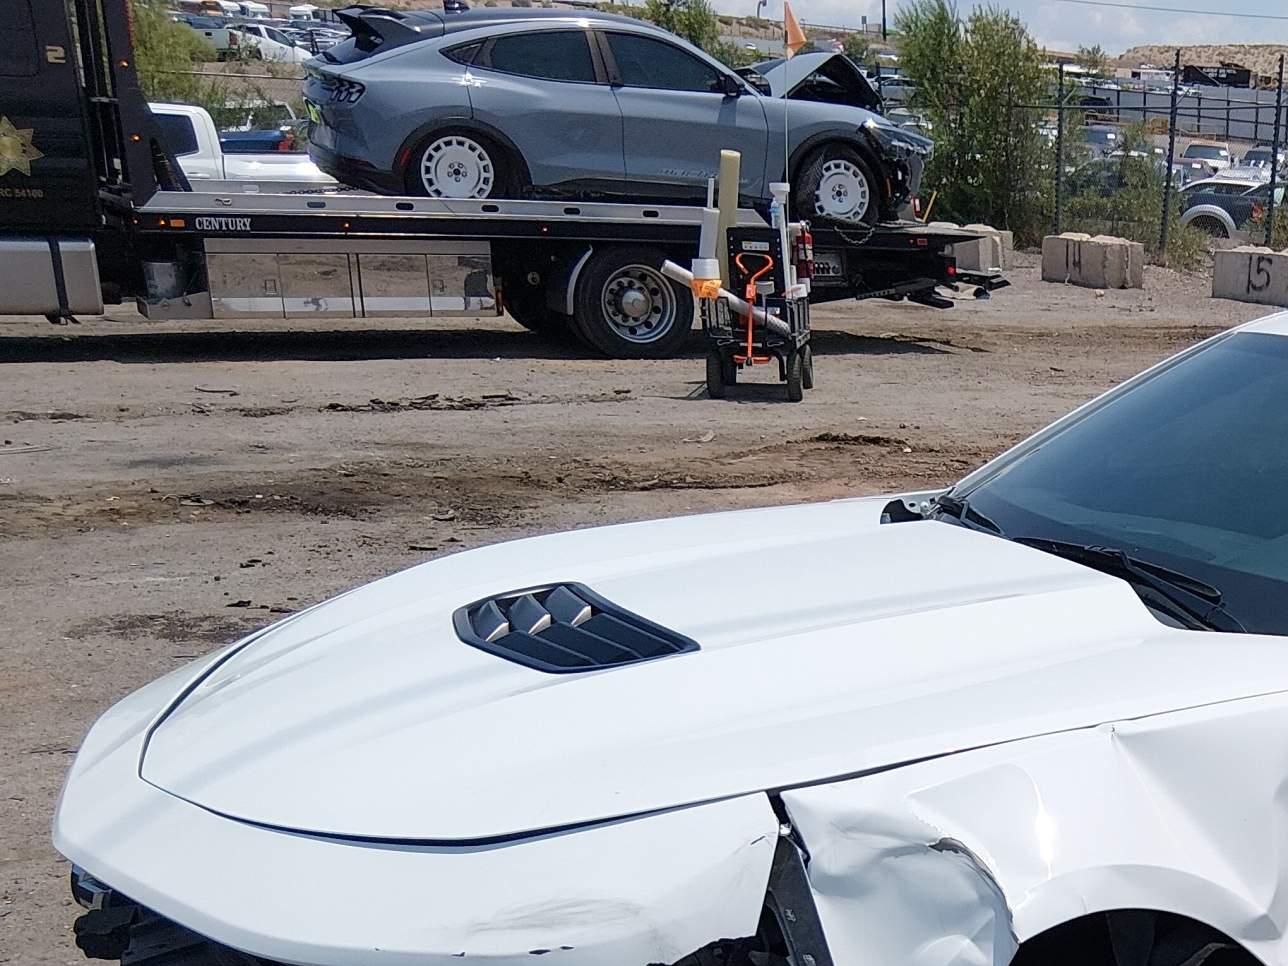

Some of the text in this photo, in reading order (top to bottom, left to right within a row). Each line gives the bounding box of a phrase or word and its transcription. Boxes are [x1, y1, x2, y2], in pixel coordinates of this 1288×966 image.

[45, 45, 66, 64] 2
[195, 216, 252, 231] CENTURY
[1246, 254, 1273, 295] 15
